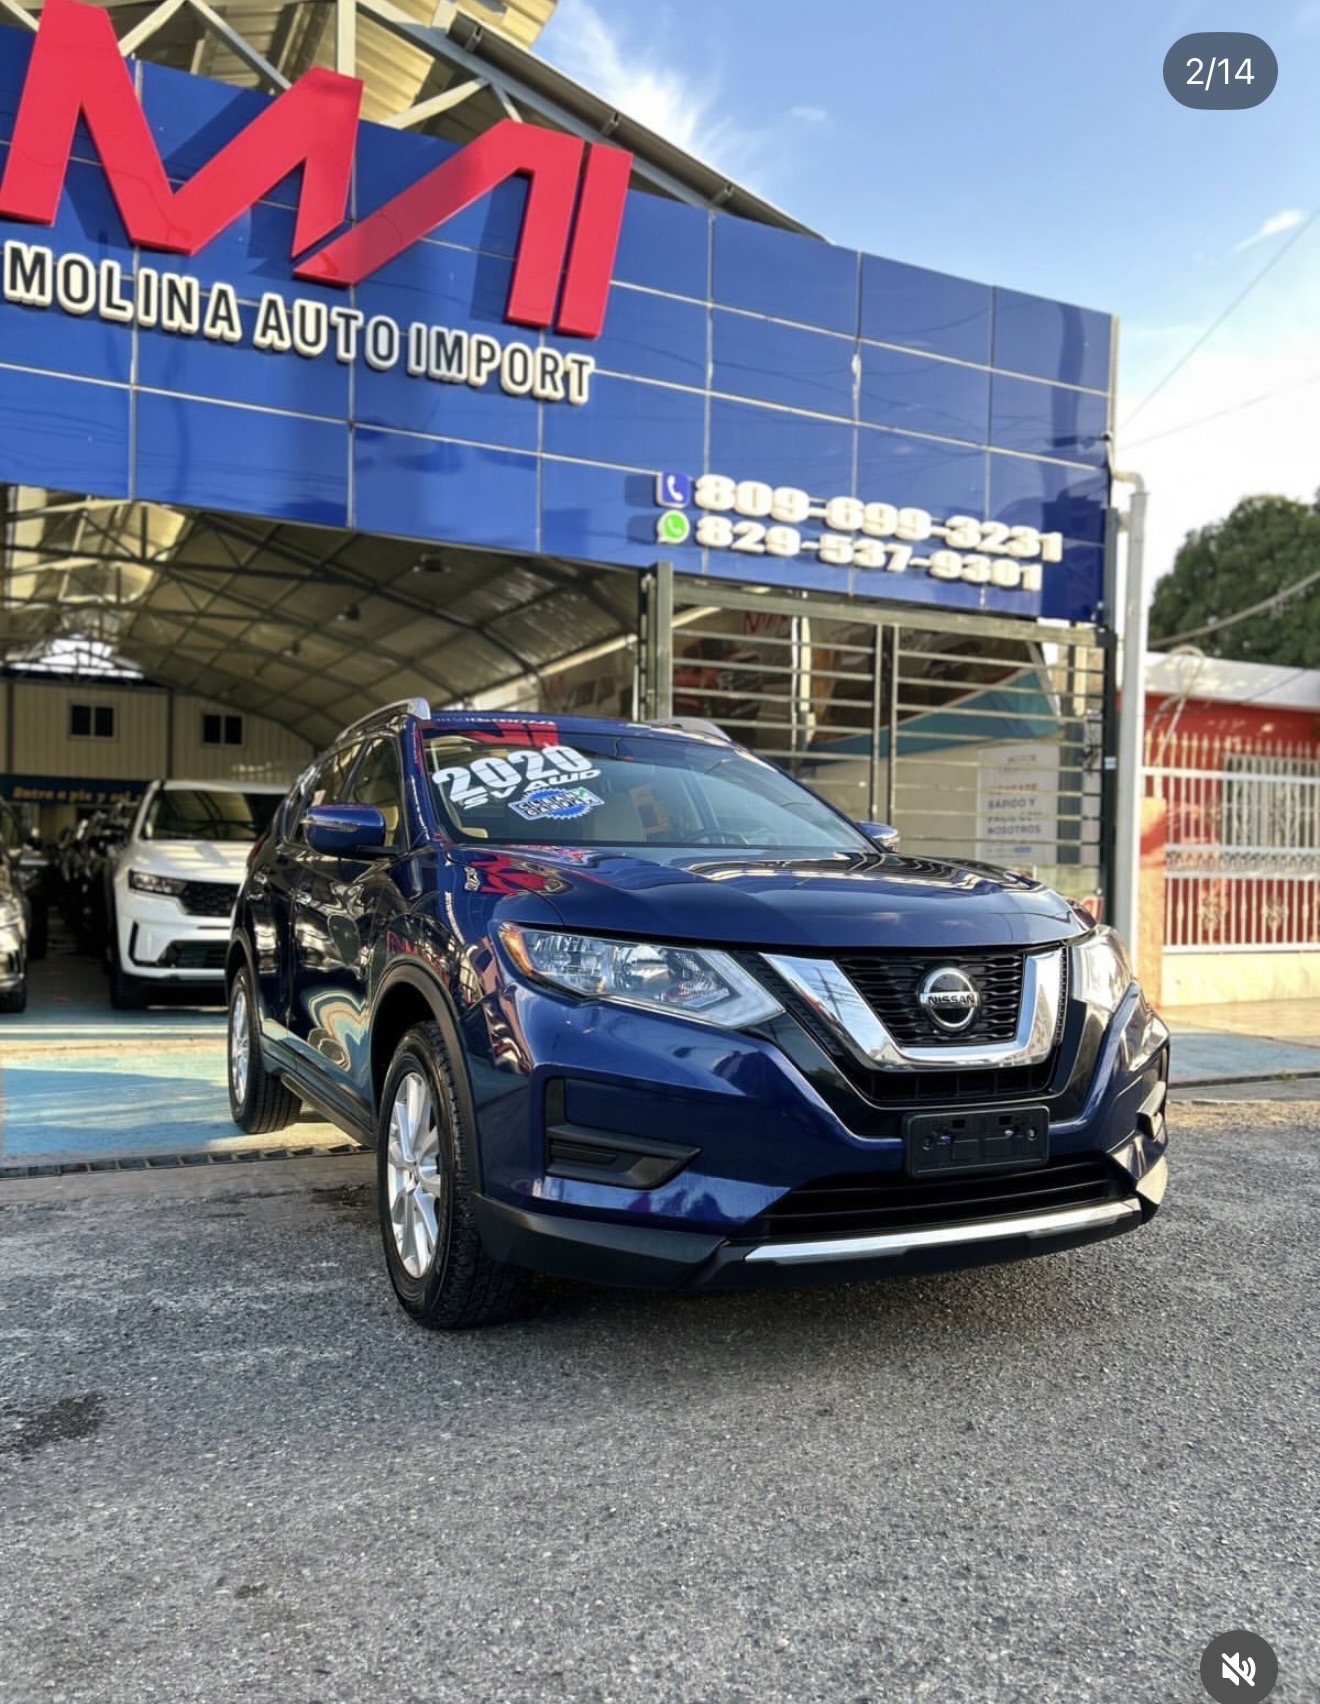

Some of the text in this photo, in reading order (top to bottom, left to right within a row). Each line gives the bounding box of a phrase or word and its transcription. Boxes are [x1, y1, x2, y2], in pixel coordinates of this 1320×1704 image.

[4, 240, 595, 406] MOLINA AUTO IMPORT
[695, 474, 1063, 563] 809-699-3231
[696, 515, 1043, 591] 829-537-9301
[432, 745, 593, 803] 2020
[462, 769, 601, 810] SV AWD
[928, 994, 975, 1004] NISSAN
